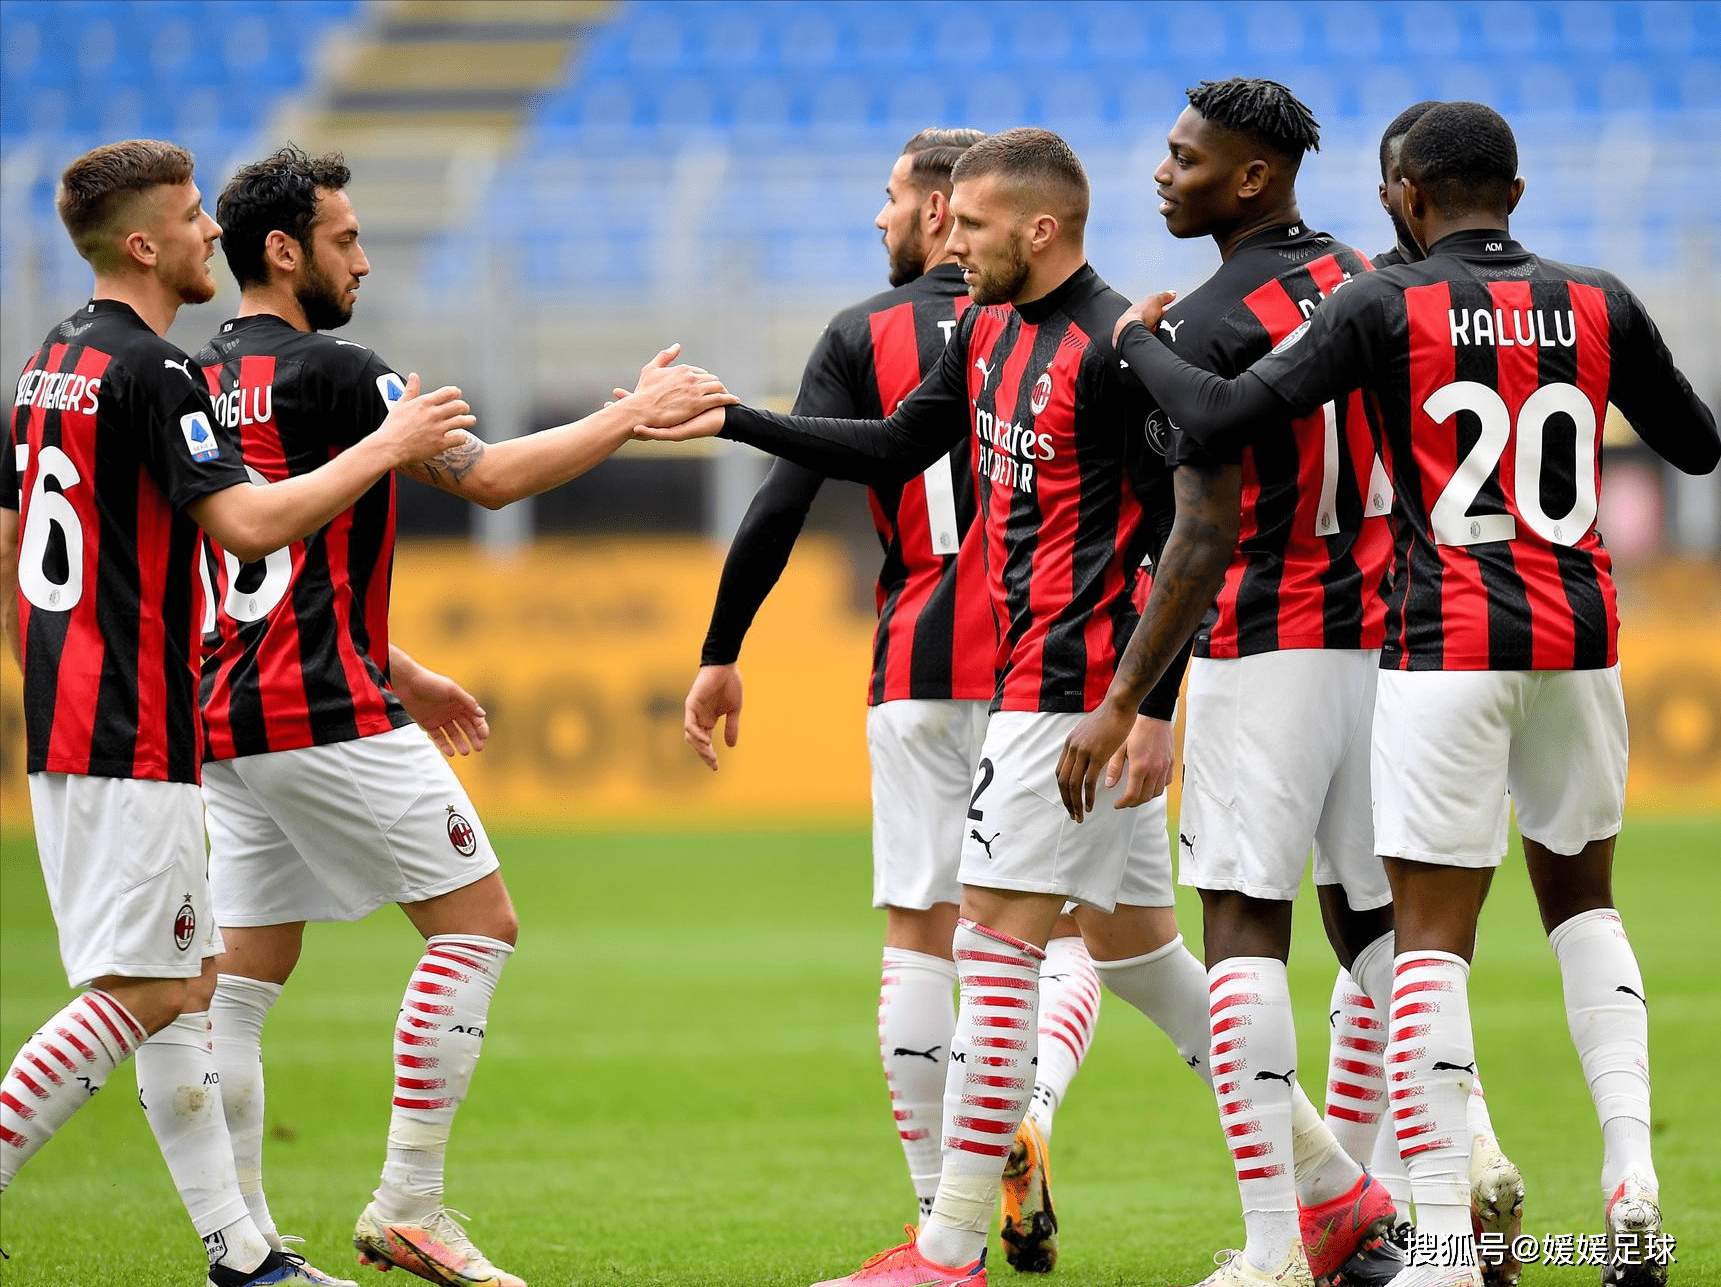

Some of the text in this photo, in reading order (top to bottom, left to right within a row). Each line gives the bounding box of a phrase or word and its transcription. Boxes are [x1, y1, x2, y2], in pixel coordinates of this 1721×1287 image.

[1485, 242, 1503, 251] ACM
[1448, 308, 1577, 347] KALULU
[991, 452, 1034, 493] BETTR
[1422, 380, 1599, 547] 20
[15, 443, 84, 612] 6
[967, 757, 994, 822] 2
